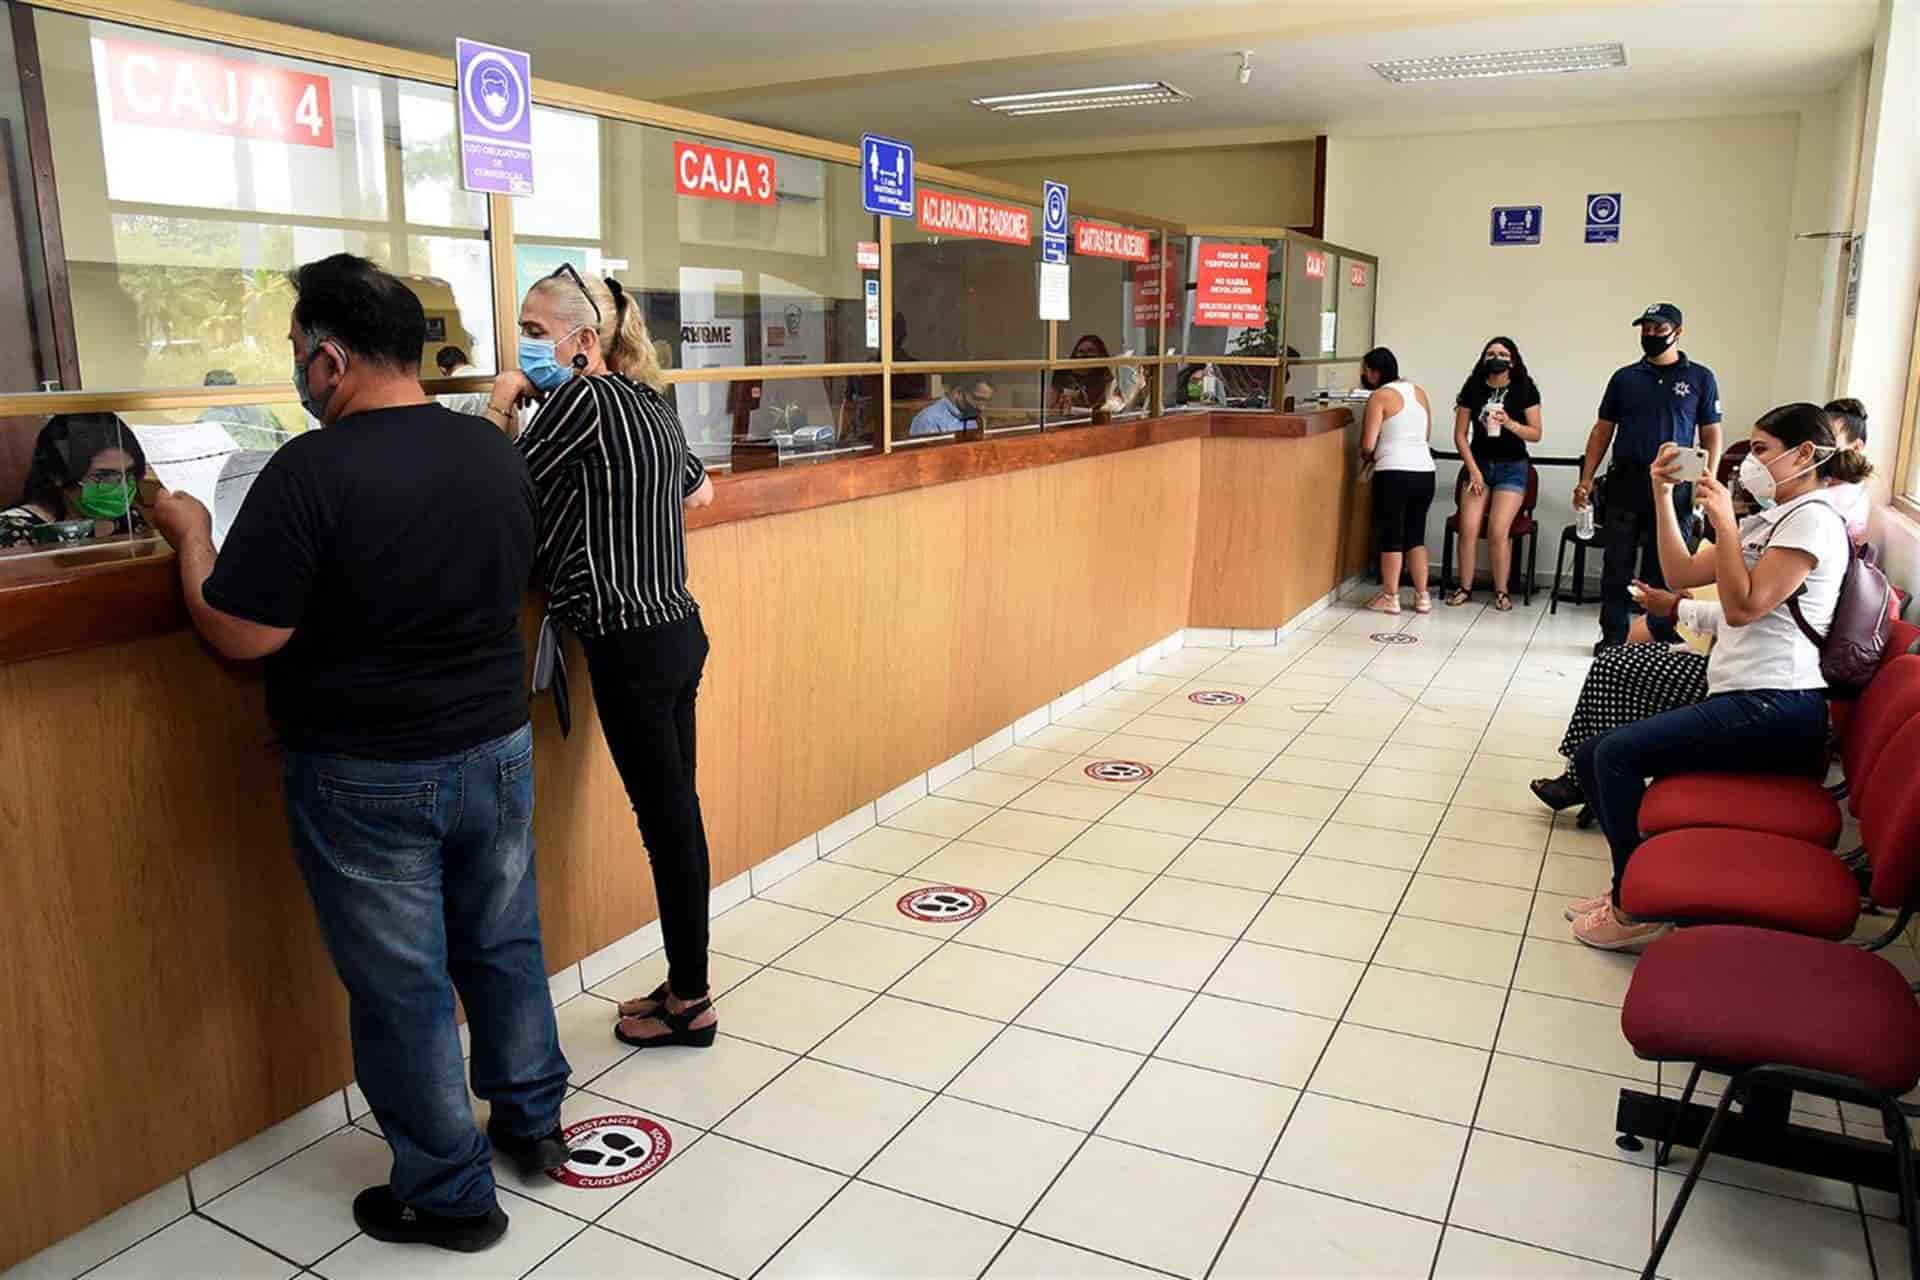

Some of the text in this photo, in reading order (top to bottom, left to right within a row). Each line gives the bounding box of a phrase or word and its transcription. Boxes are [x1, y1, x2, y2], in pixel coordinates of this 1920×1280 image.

[121, 54, 323, 136] CAJA 4
[680, 150, 771, 199] CAJA 3
[922, 196, 1029, 241] ACLARACION DE PADRONES
[571, 1118, 638, 1133] DISTANCIA
